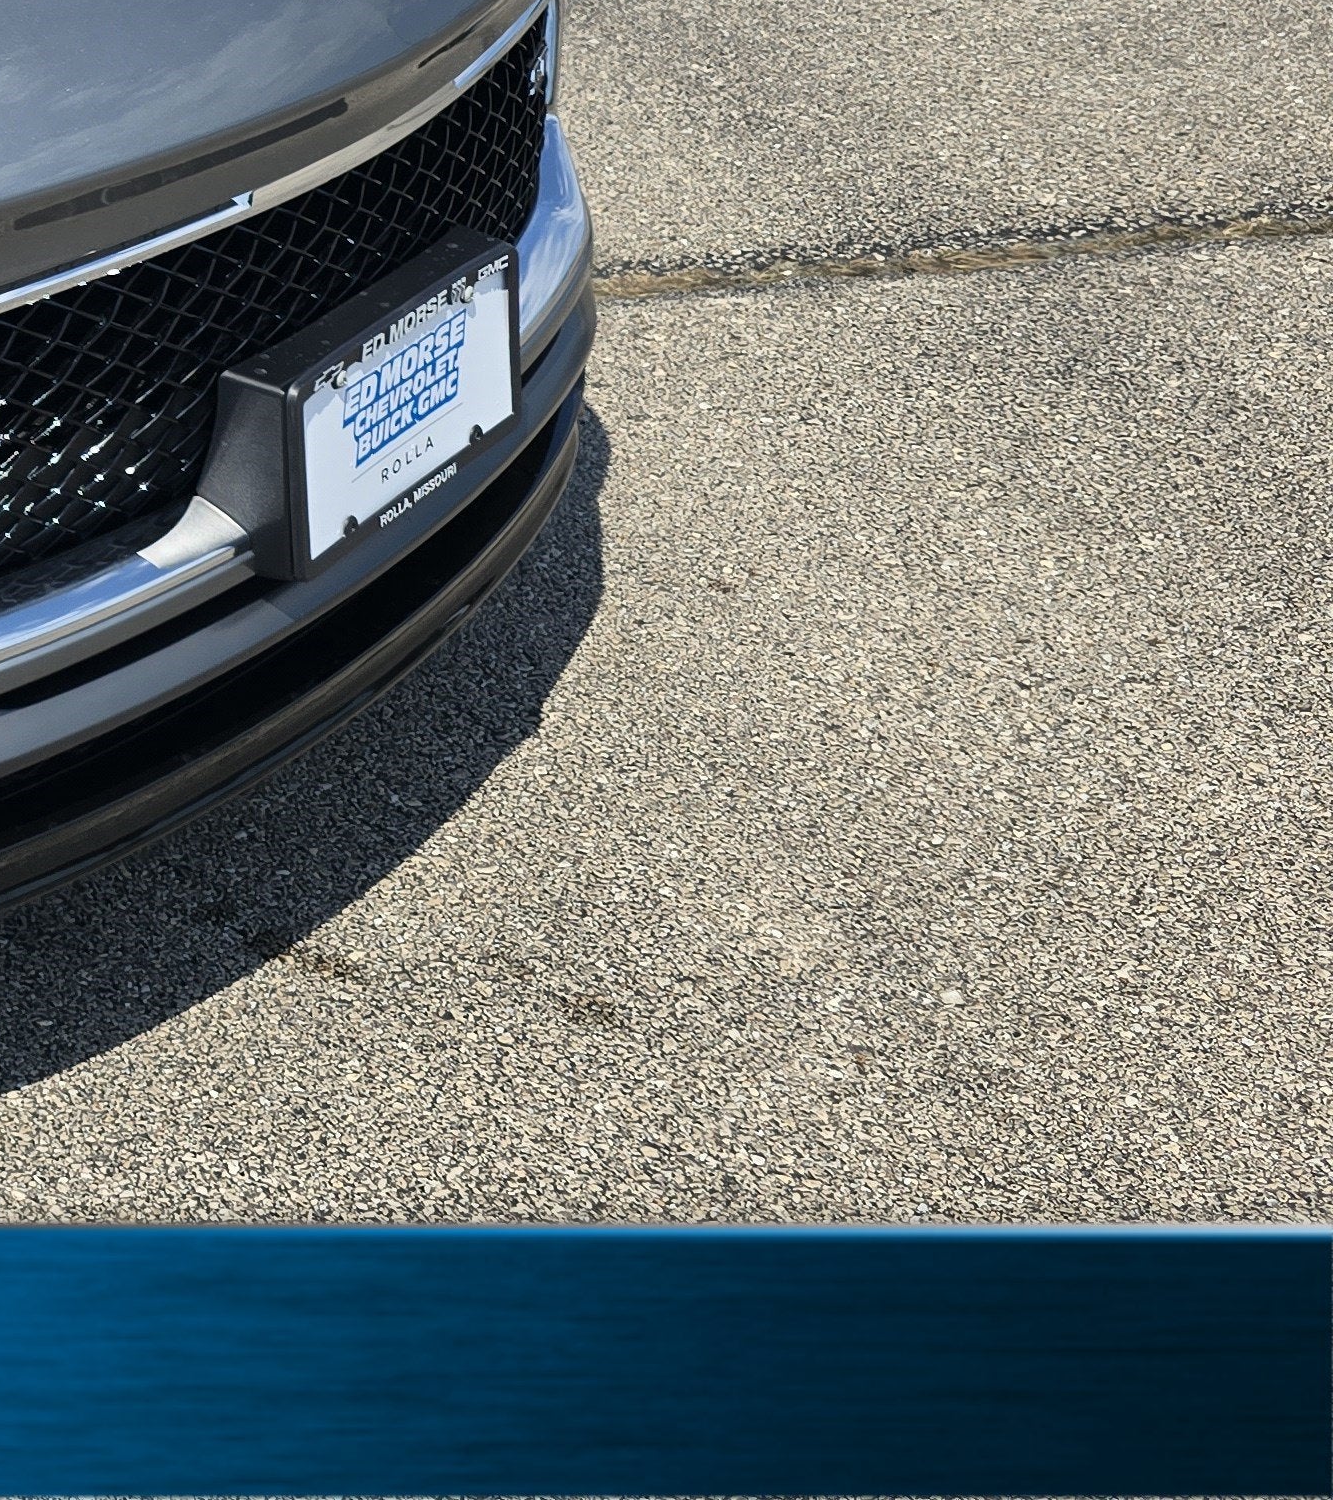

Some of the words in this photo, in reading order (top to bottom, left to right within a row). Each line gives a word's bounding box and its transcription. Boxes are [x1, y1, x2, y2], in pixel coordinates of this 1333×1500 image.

[477, 255, 509, 281] GMC
[361, 332, 386, 363] ED
[388, 289, 448, 344] MORSE
[345, 370, 378, 421] ED
[378, 316, 466, 396] MORSE
[357, 398, 415, 461] BUICK
[417, 374, 458, 416] GMC
[381, 436, 434, 483] ROLLA
[379, 497, 413, 528] ROLLA,
[413, 462, 458, 503] MISSOURI
